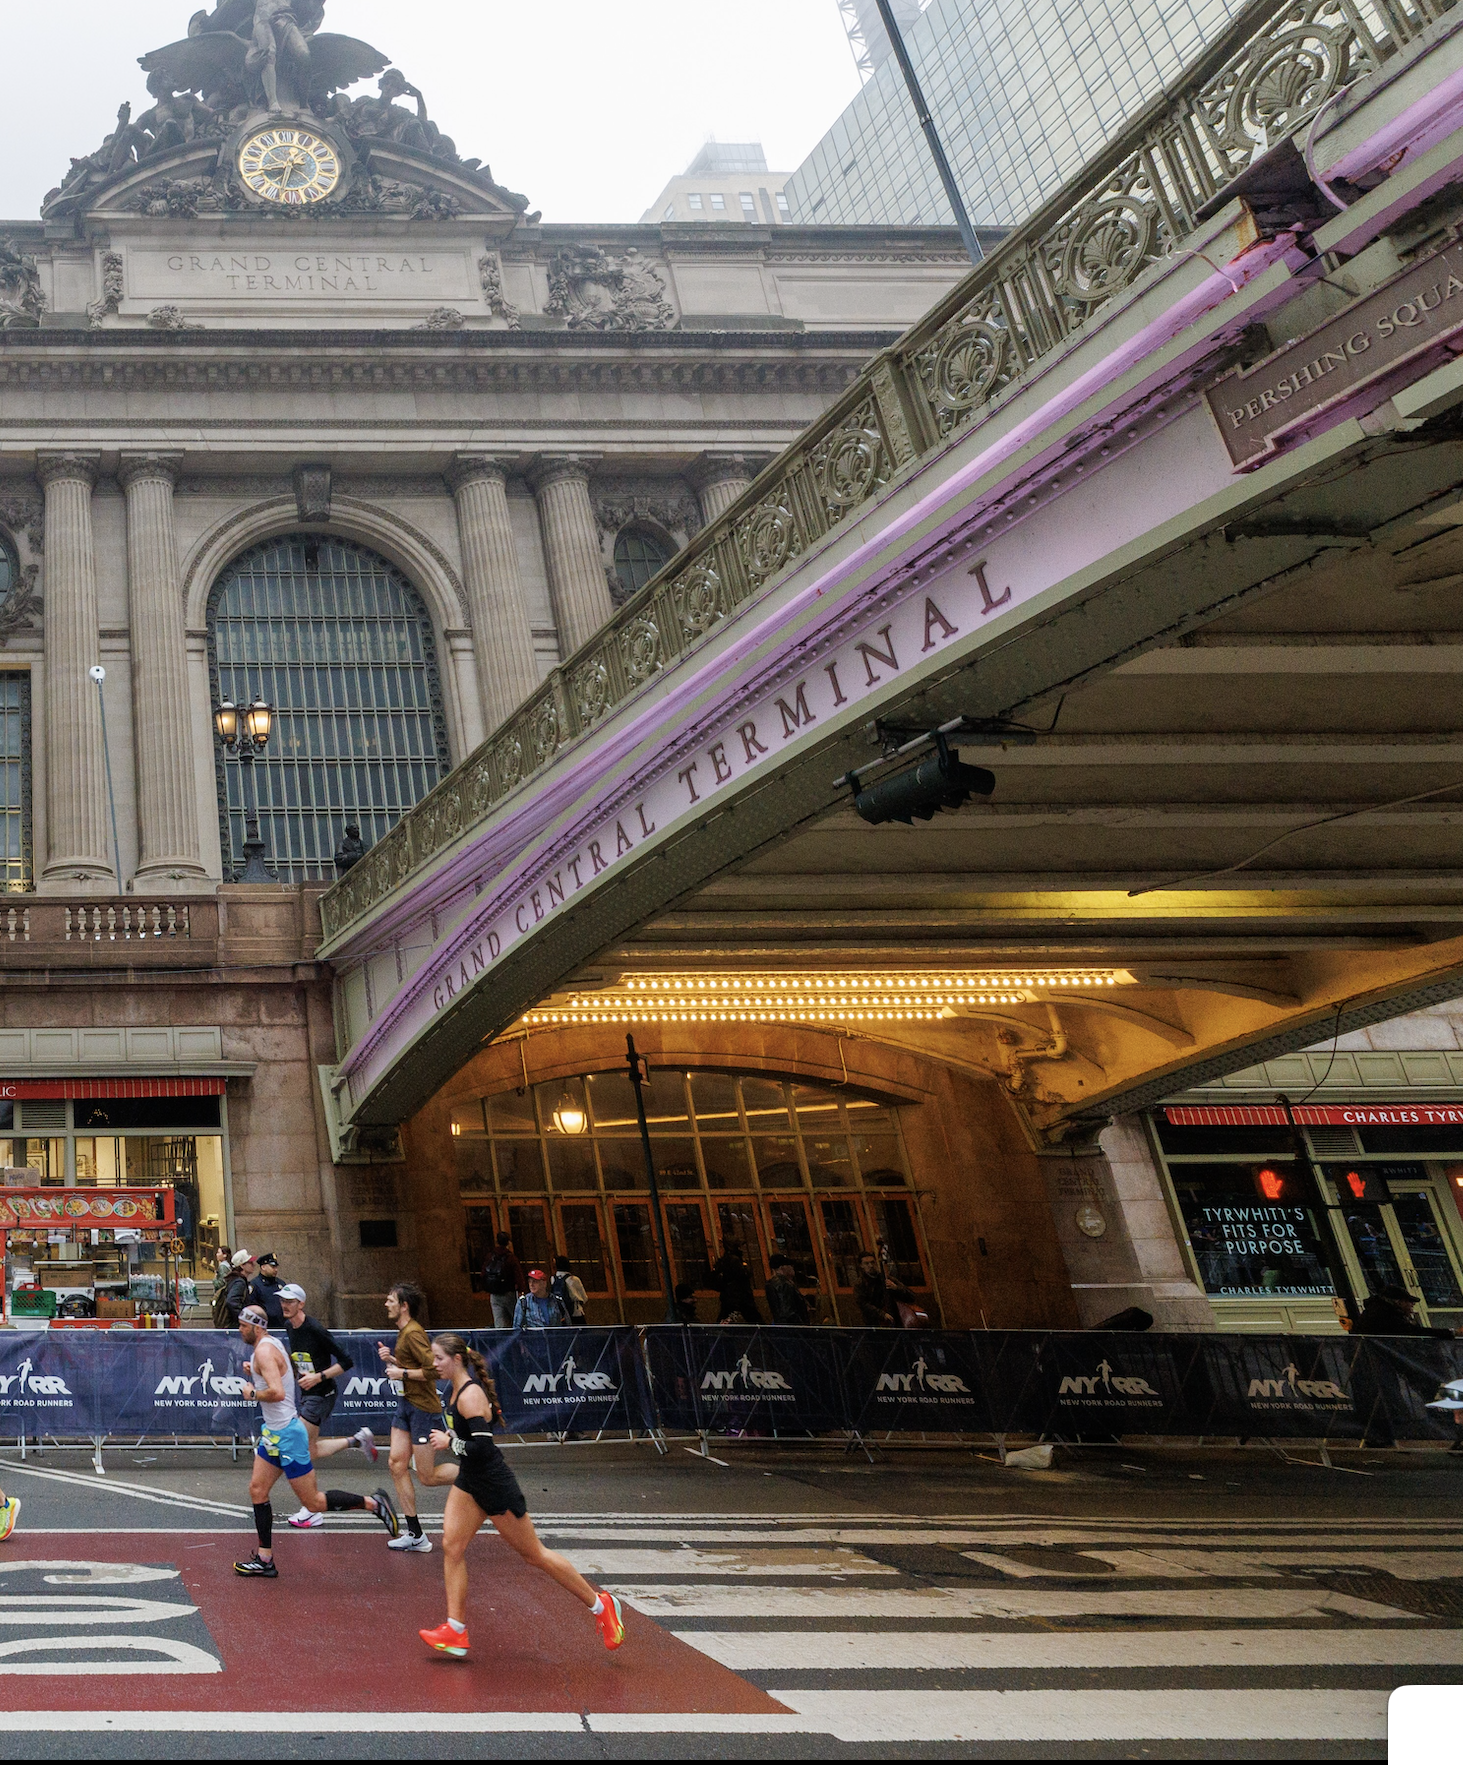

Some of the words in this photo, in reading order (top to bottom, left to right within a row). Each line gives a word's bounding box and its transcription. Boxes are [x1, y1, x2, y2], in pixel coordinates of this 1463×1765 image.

[167, 256, 271, 271] GRAND
[294, 256, 434, 273] CENTRAL
[227, 275, 378, 291] TERMINAL
[1230, 331, 1371, 430] PERSHING
[432, 930, 502, 1011] GRAND
[514, 802, 658, 933] CENTRAL
[677, 558, 1012, 805] TERMINAL
[1343, 1111, 1419, 1122] CHARLES
[1203, 1207, 1304, 1222] TYRWHITT'S
[1222, 1224, 1256, 1238] FITS
[1263, 1223, 1297, 1238] FOR
[1226, 1239, 1304, 1255] PURPOSE
[1220, 1286, 1271, 1295] CHARLES
[1276, 1285, 1334, 1294] TYRWHITT
[523, 1371, 618, 1392] NYRR
[700, 1371, 792, 1389] NYRR
[876, 1373, 971, 1393] NYRR
[1059, 1376, 1159, 1395] NYRR
[1248, 1379, 1350, 1399] NYRR
[37, 1399, 73, 1407] RUNNERS
[363, 1400, 384, 1408] YORK
[523, 1397, 541, 1405] NEW
[564, 1396, 586, 1404] ROAD
[588, 1394, 620, 1402] RUNNERS
[762, 1394, 796, 1402] RUNNERS
[940, 1397, 975, 1405] RUNNERS
[1128, 1399, 1163, 1407] RUNNERS
[1270, 1402, 1291, 1410] YORK
[1315, 1403, 1353, 1411] RUNNERS
